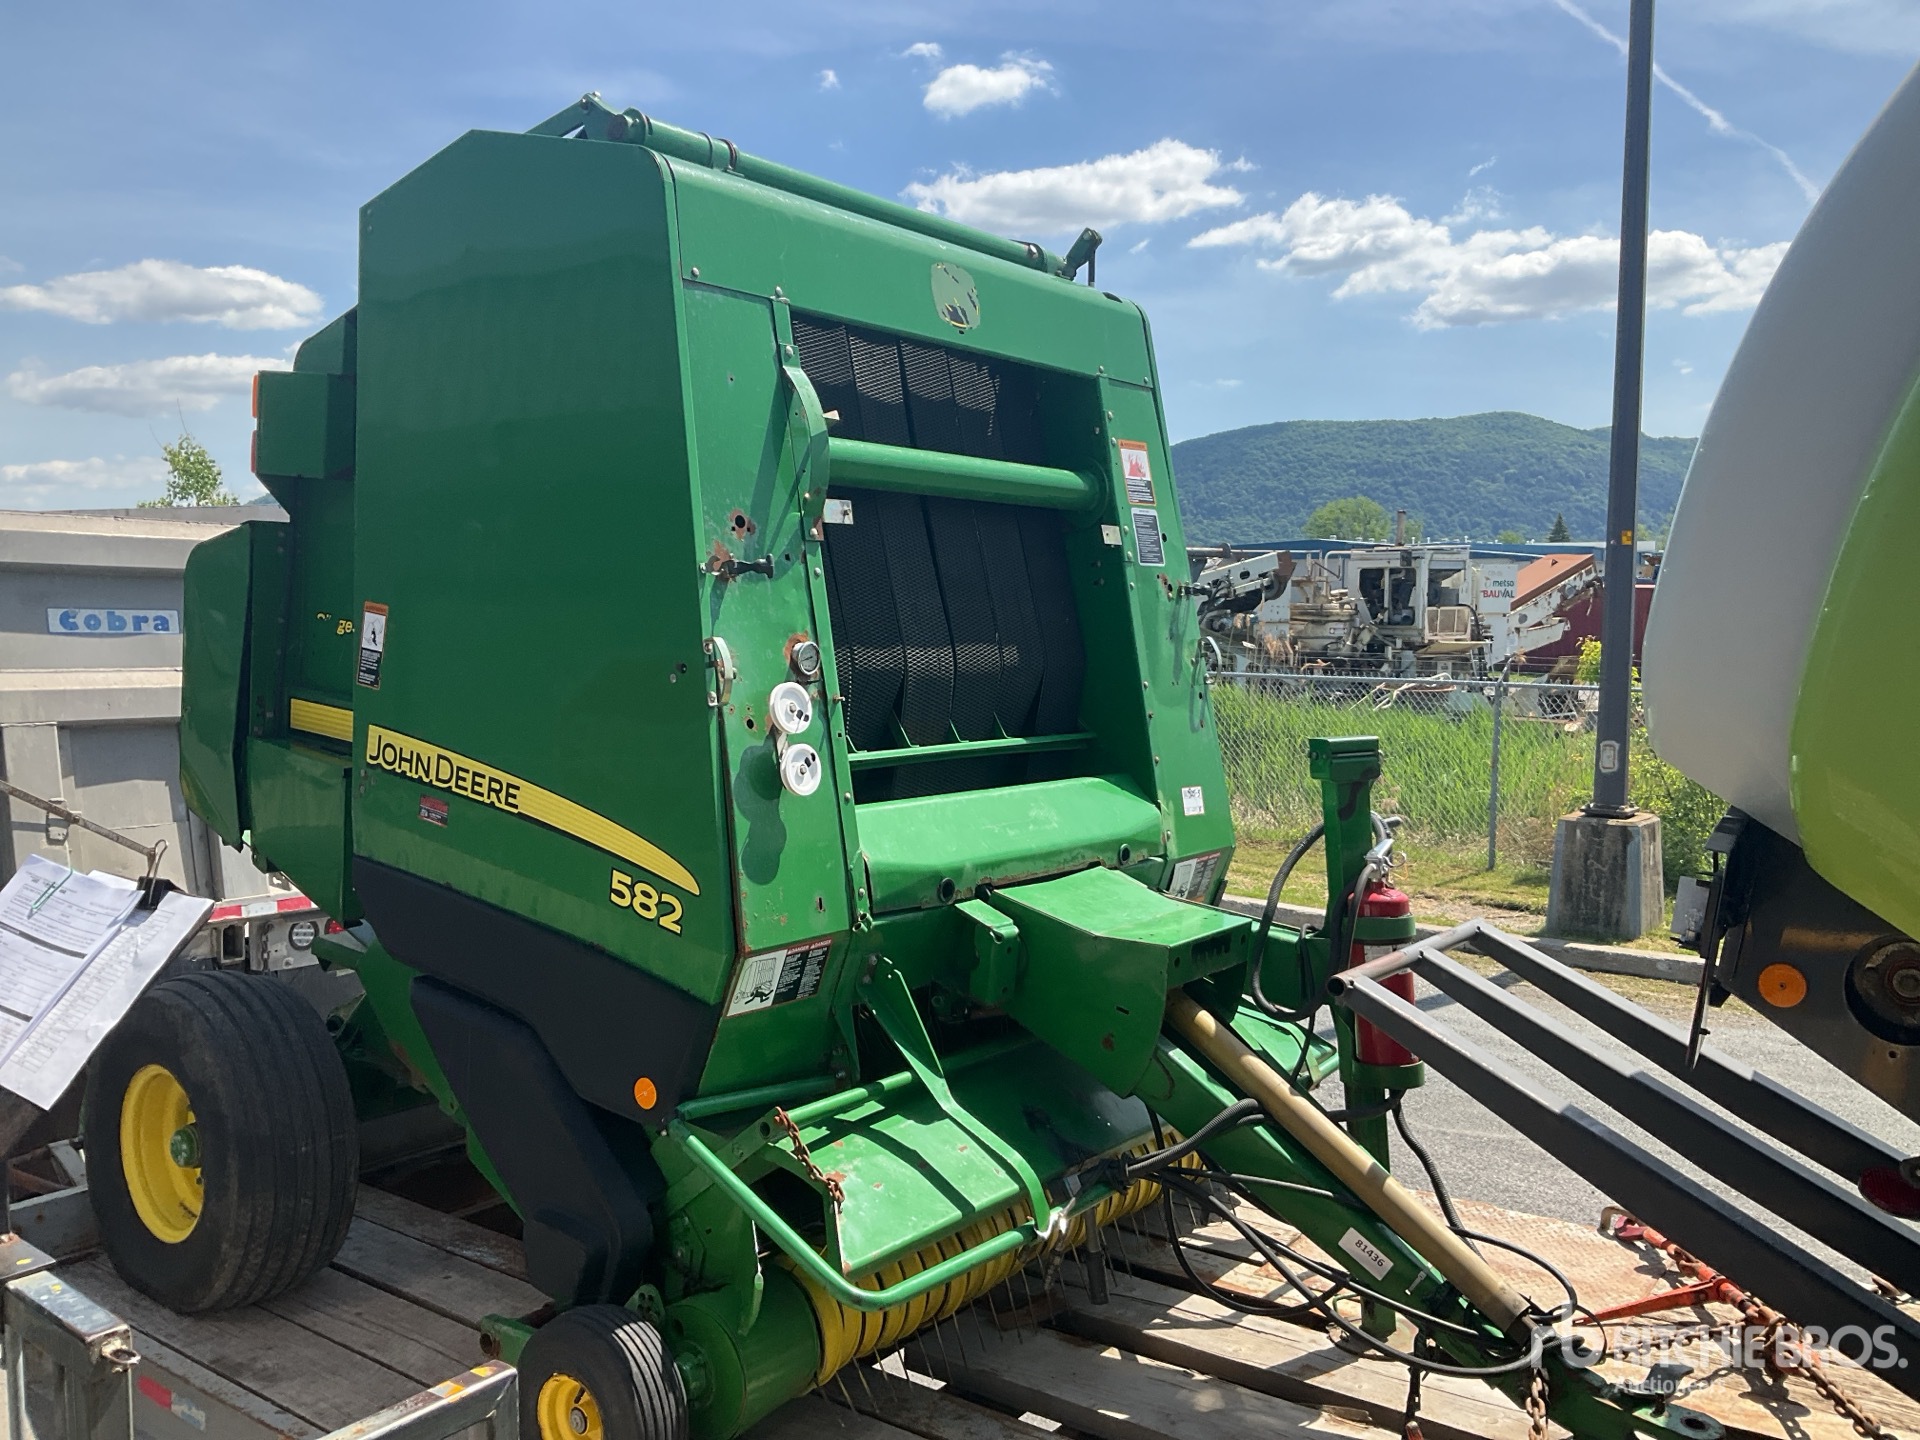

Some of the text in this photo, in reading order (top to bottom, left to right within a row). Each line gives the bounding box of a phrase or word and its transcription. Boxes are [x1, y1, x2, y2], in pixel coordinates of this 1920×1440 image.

[1481, 588, 1515, 598] BAUVAL
[59, 610, 170, 631] Cobra
[369, 735, 521, 809] JOHN DEERE
[609, 867, 684, 936] 582
[1355, 1239, 1385, 1267] 81436
